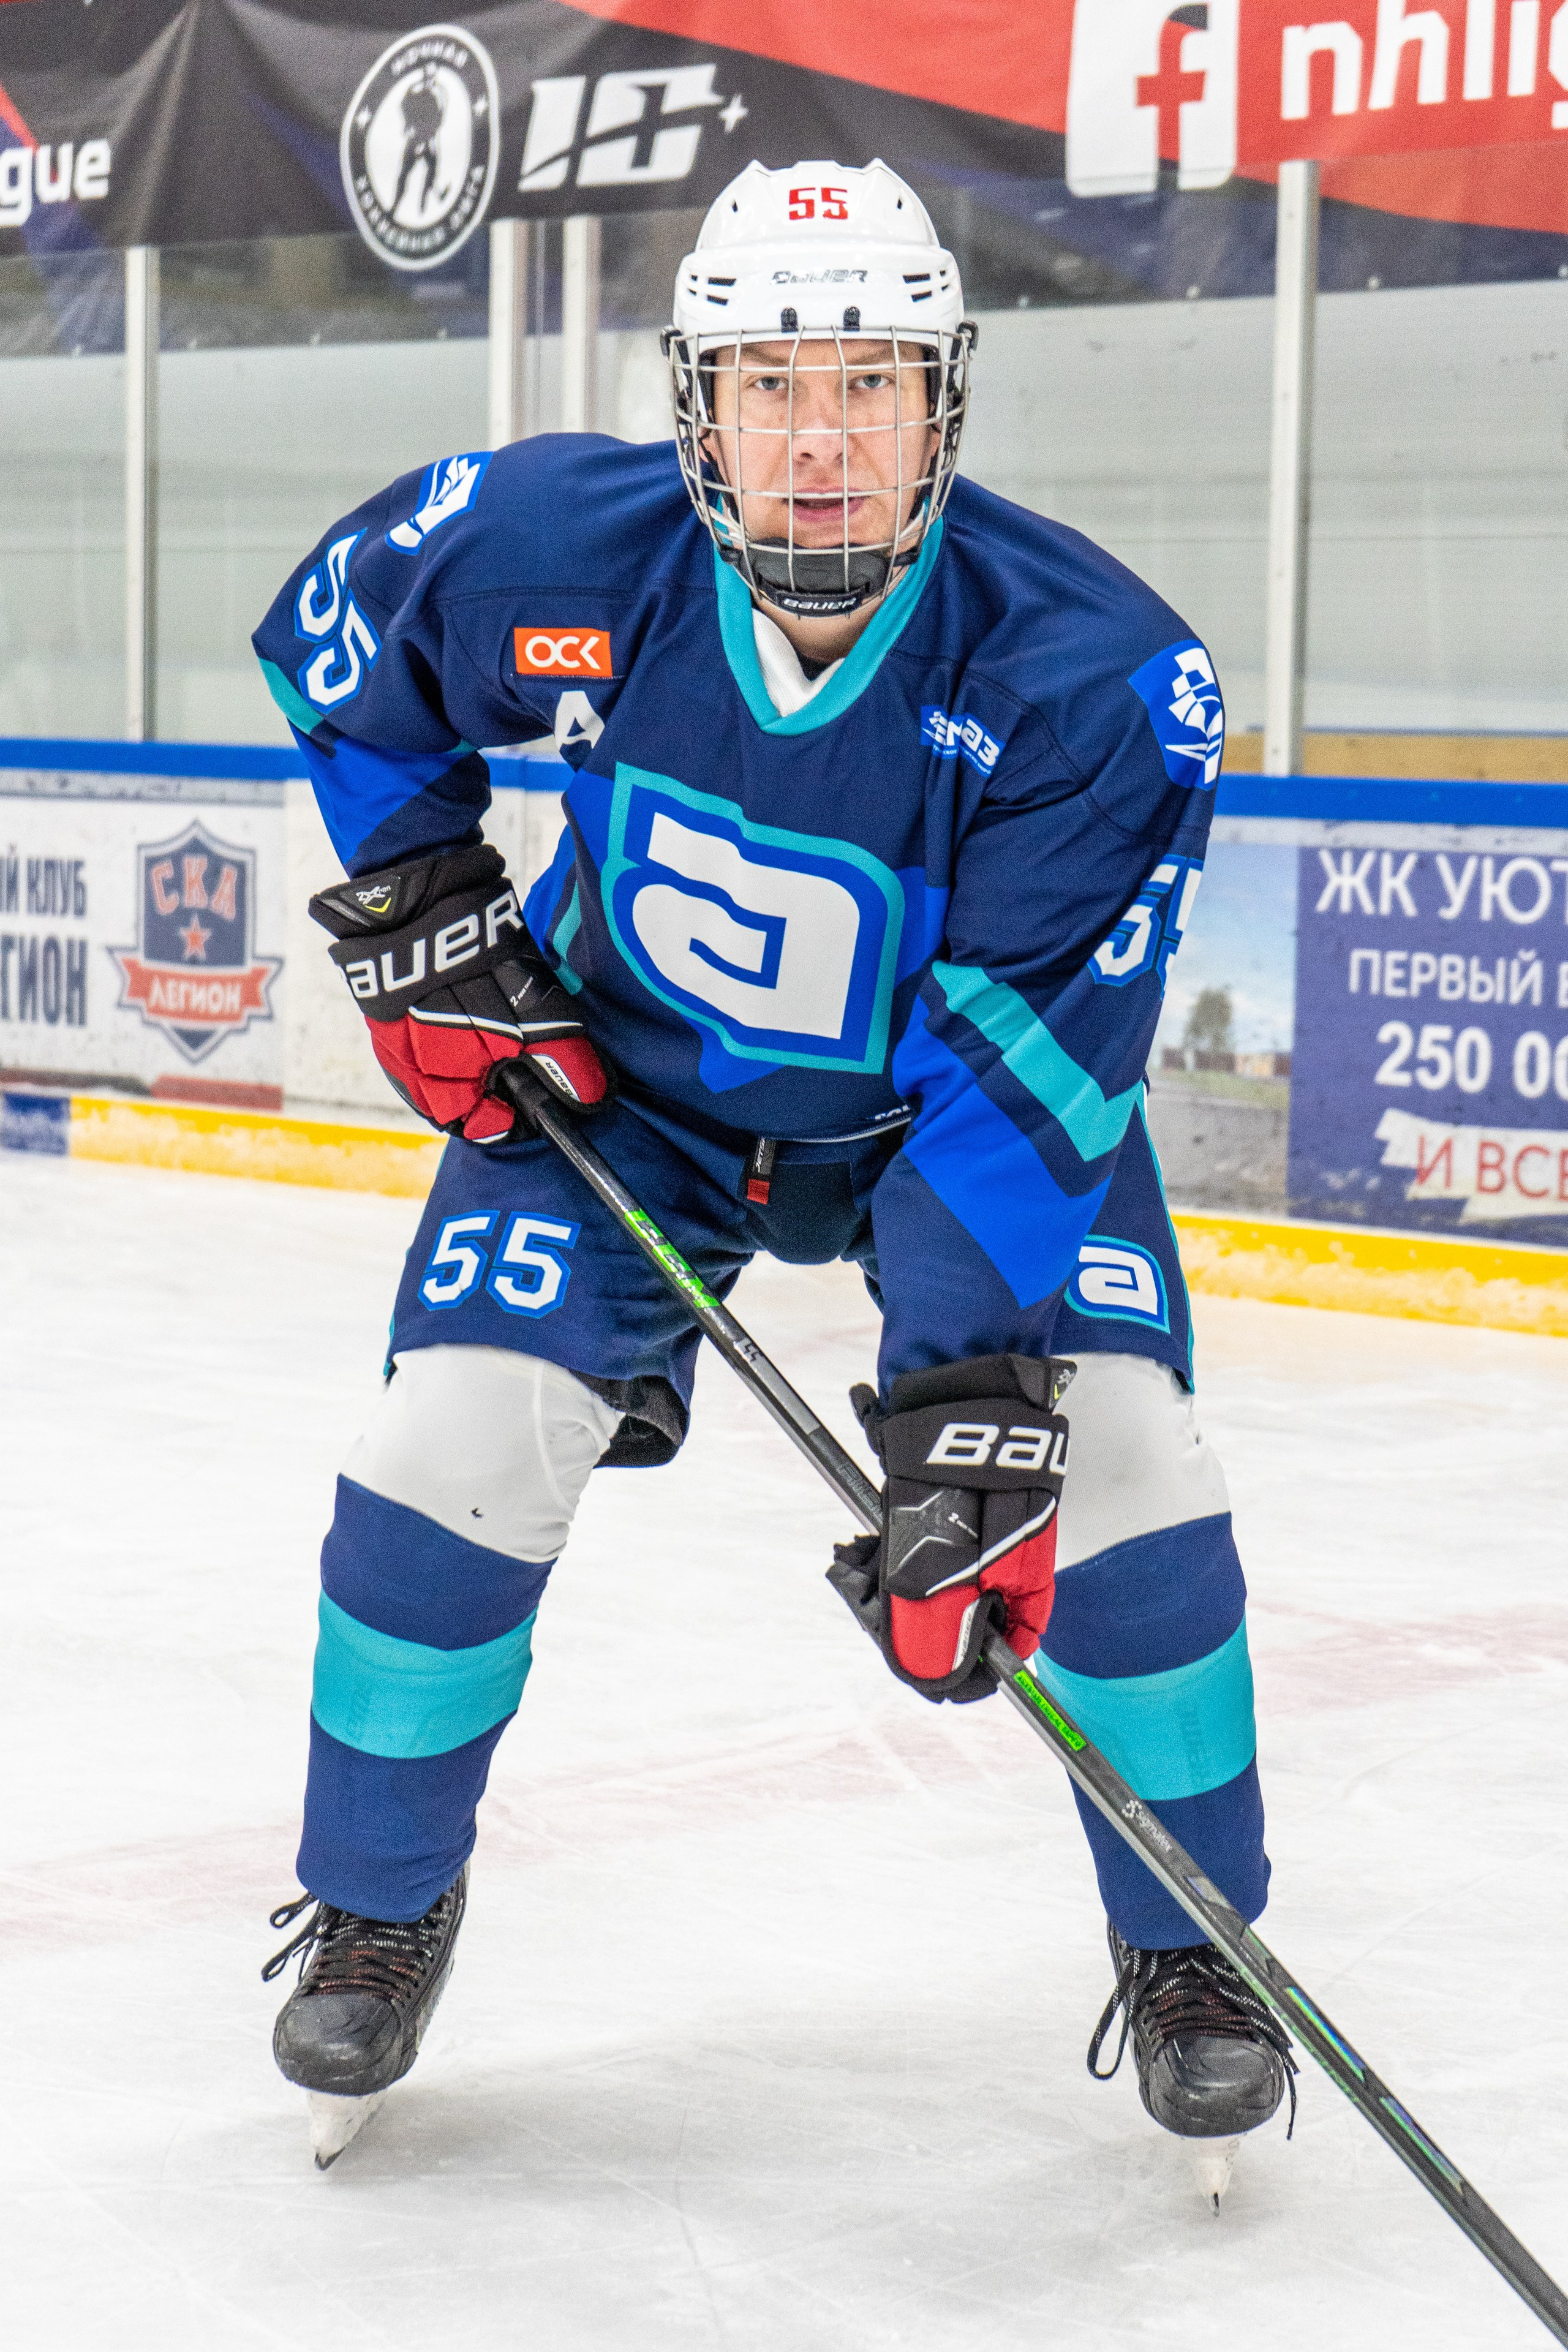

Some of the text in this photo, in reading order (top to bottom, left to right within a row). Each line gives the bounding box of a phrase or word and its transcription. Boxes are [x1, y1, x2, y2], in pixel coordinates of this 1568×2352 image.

[789, 187, 848, 221] 55
[26, 855, 88, 919] КЛУБ
[151, 856, 238, 922] СКА
[1316, 850, 1418, 918] ЖК
[149, 978, 243, 1014] ЛЕГИОН
[1349, 948, 1544, 1006] ПЕРВЫЙ
[1374, 1020, 1493, 1094] 250
[1415, 1134, 1454, 1190] И
[421, 1213, 575, 1312] 55
[625, 1208, 720, 1308] CCM
